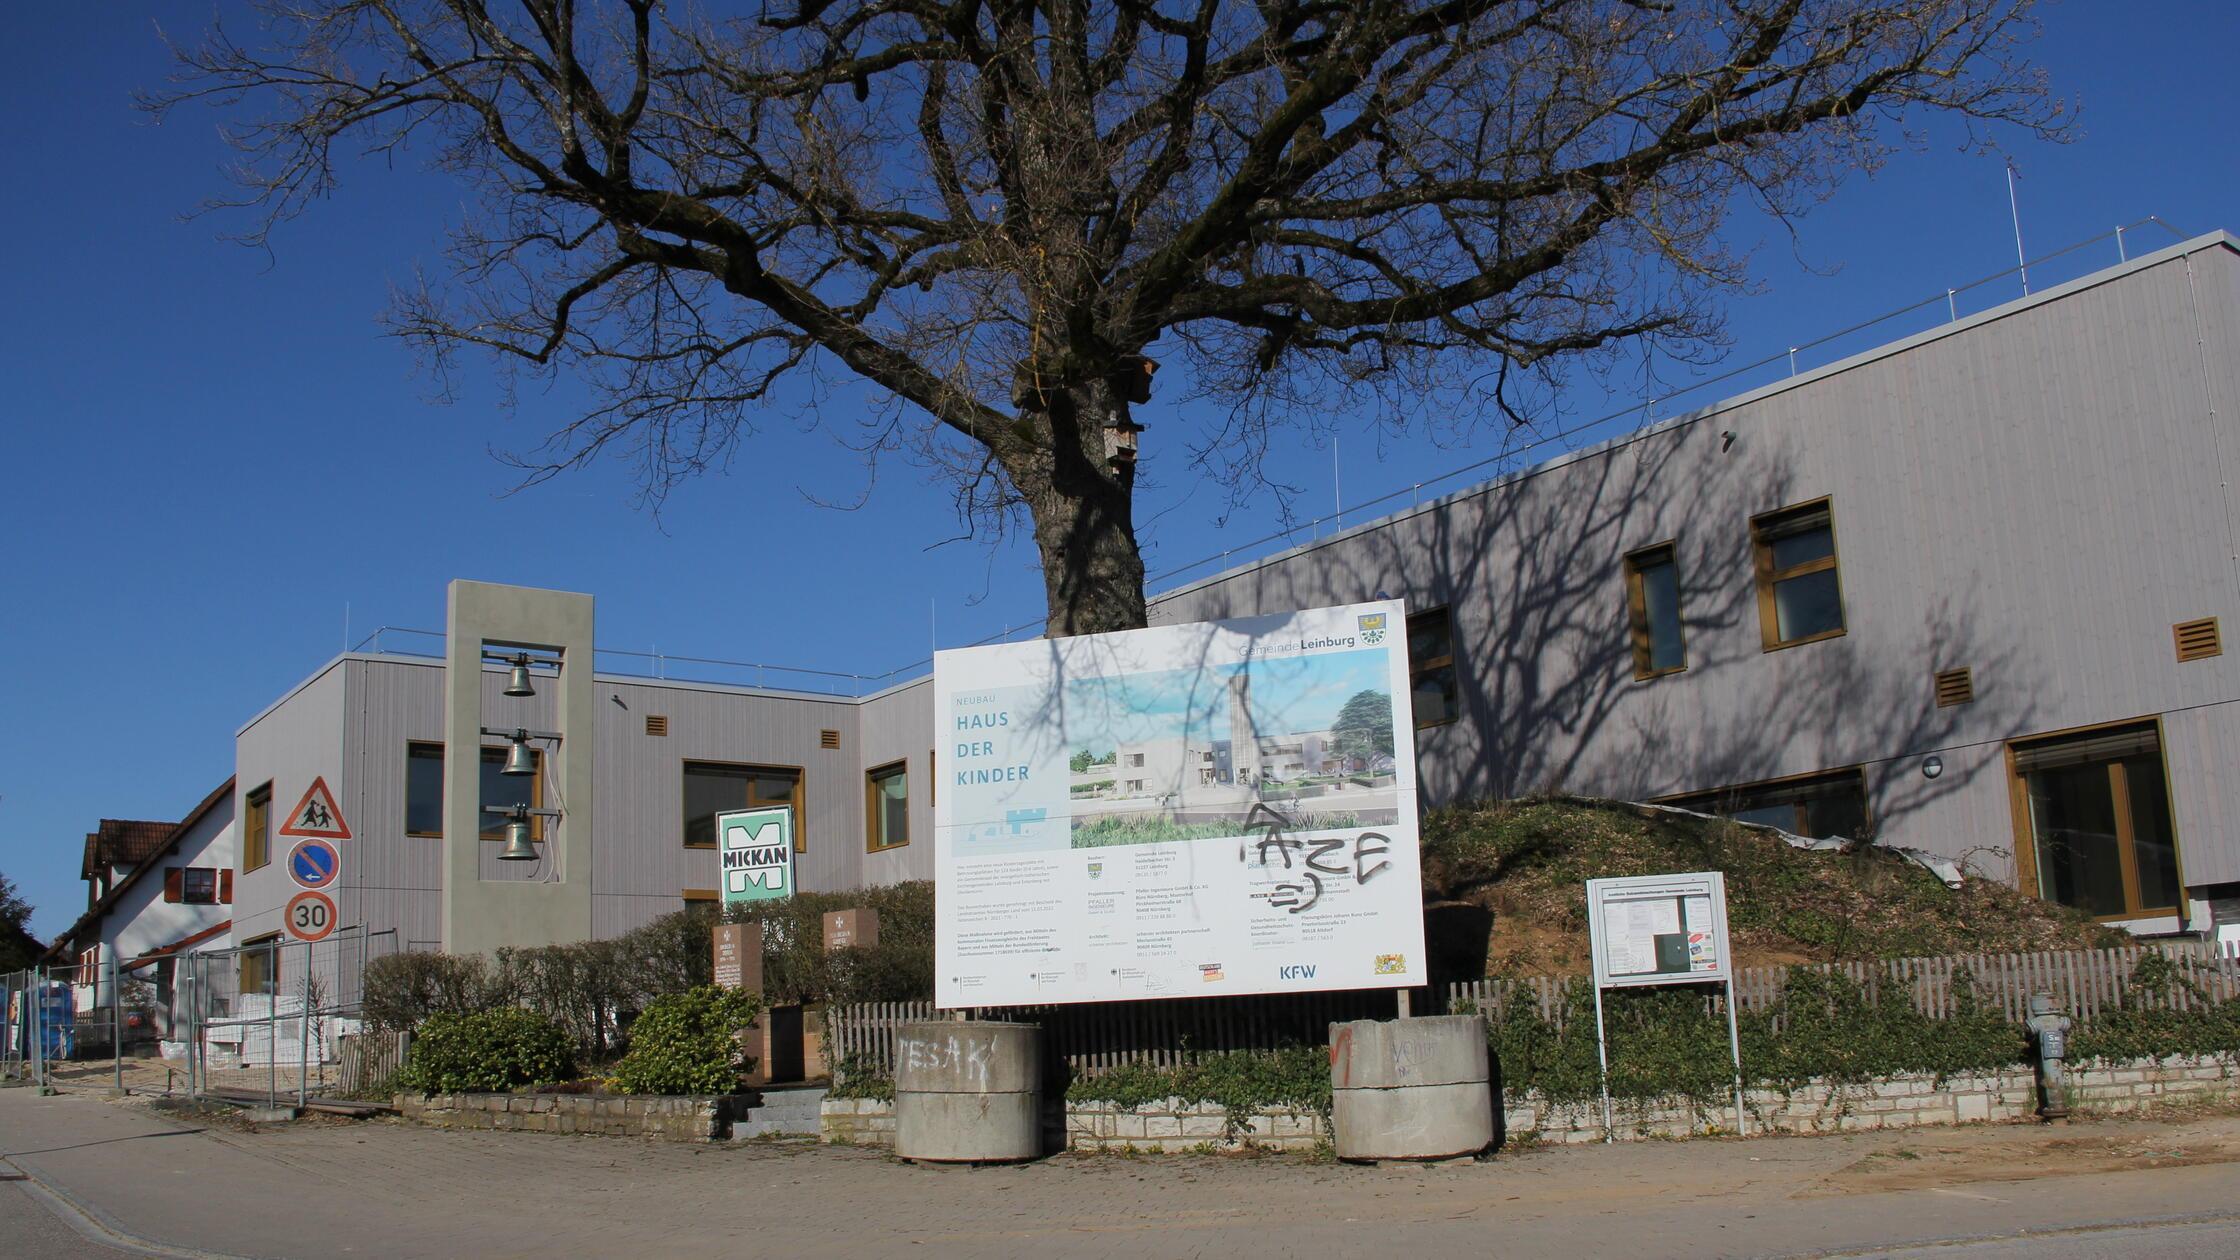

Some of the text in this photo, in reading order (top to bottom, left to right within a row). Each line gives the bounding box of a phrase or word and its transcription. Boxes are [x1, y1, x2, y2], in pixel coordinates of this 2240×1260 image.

[956, 696, 995, 705] NEUBAU
[957, 712, 1008, 730] HAUS
[957, 741, 993, 758] DER
[957, 766, 1029, 786] KINDER
[723, 847, 787, 868] MICKAN
[296, 905, 325, 927] 30
